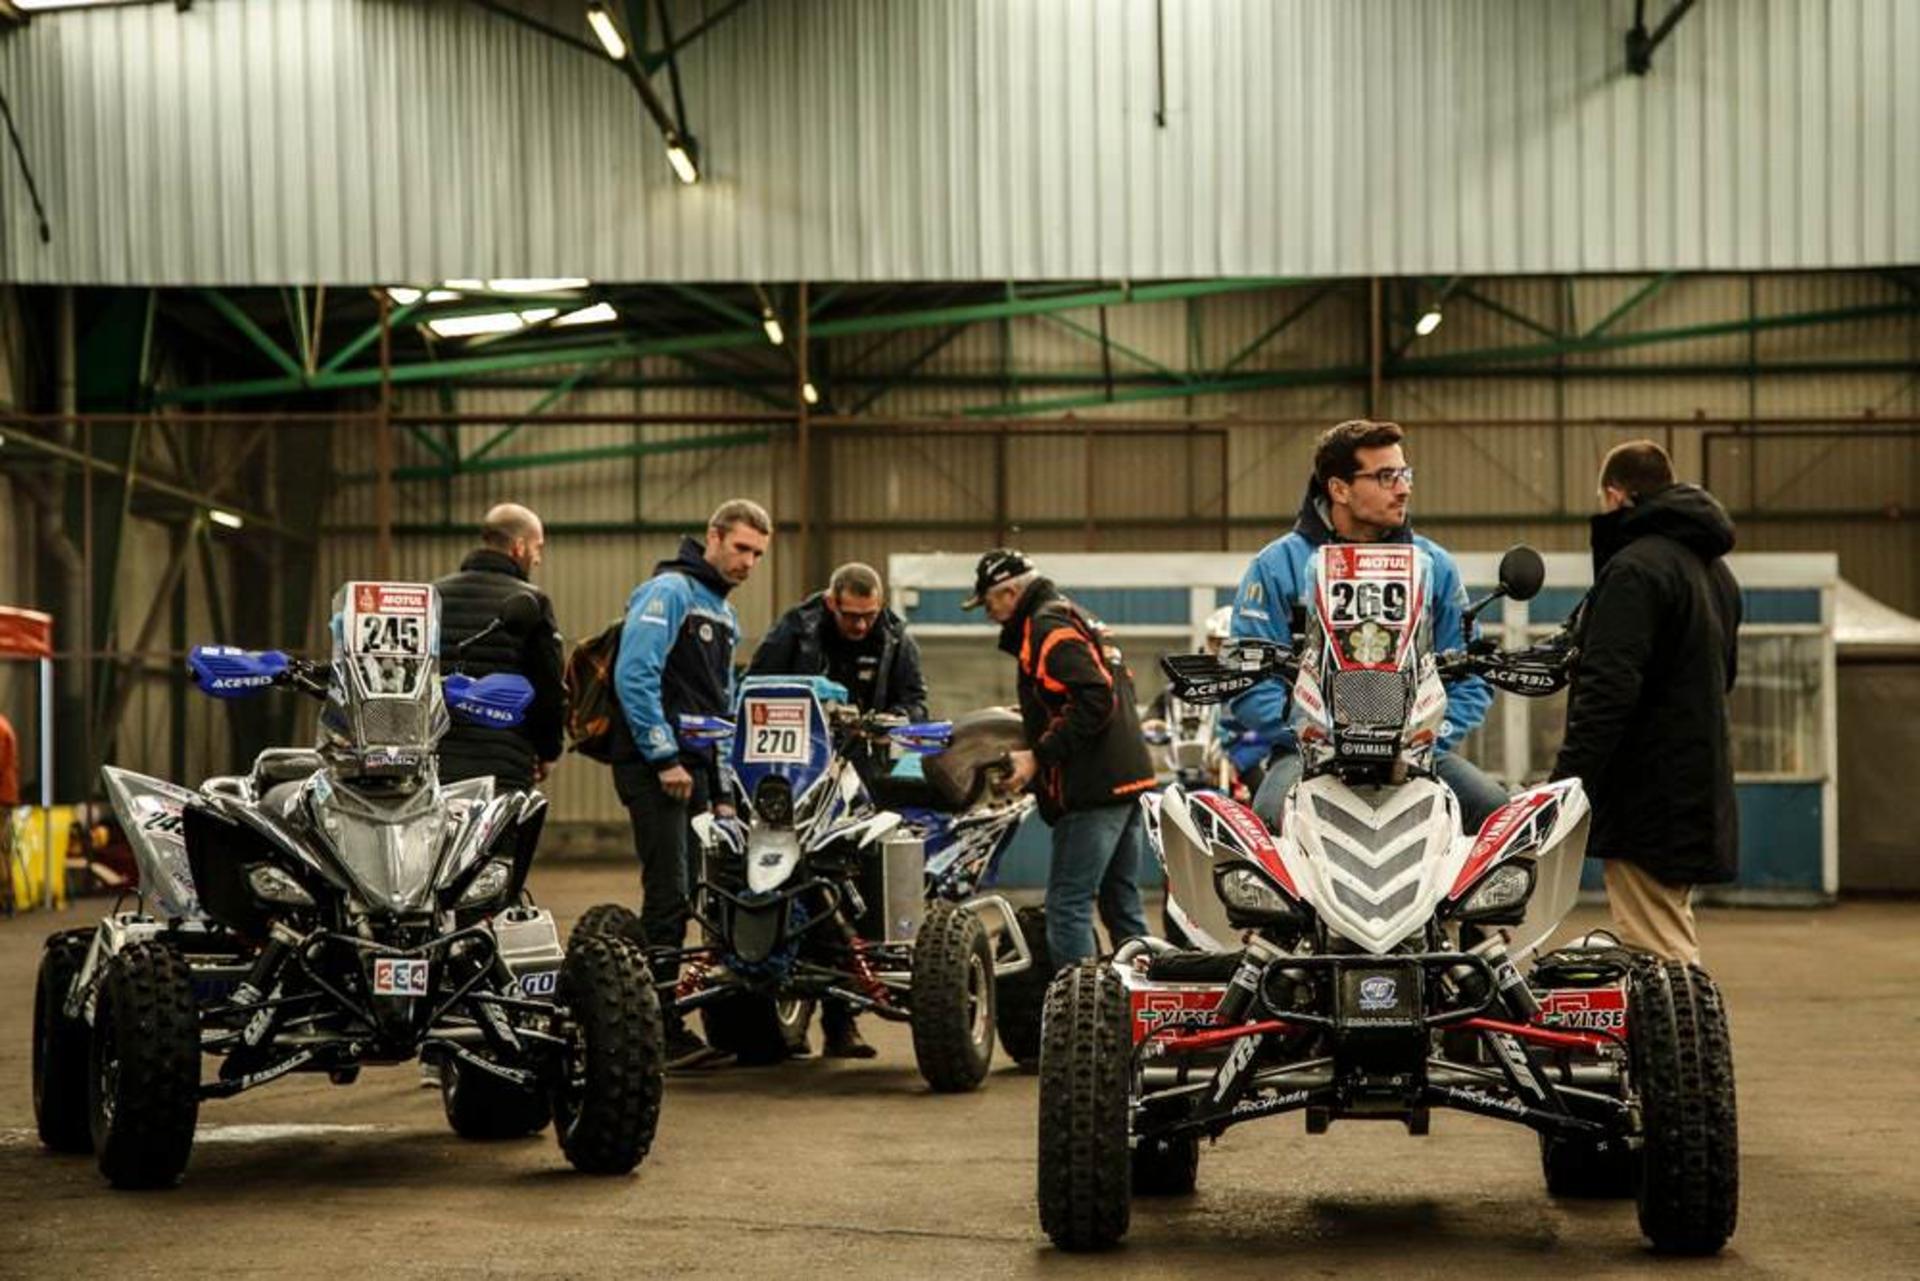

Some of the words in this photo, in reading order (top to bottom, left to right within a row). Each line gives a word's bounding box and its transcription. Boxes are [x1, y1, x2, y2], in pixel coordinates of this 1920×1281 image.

[1358, 557, 1407, 570] MOTUL
[1331, 582, 1408, 622] 269
[362, 616, 420, 655] 245
[756, 728, 797, 754] 270
[1353, 743, 1394, 755] YAMAHA
[1566, 1009, 1626, 1028] VITSE
